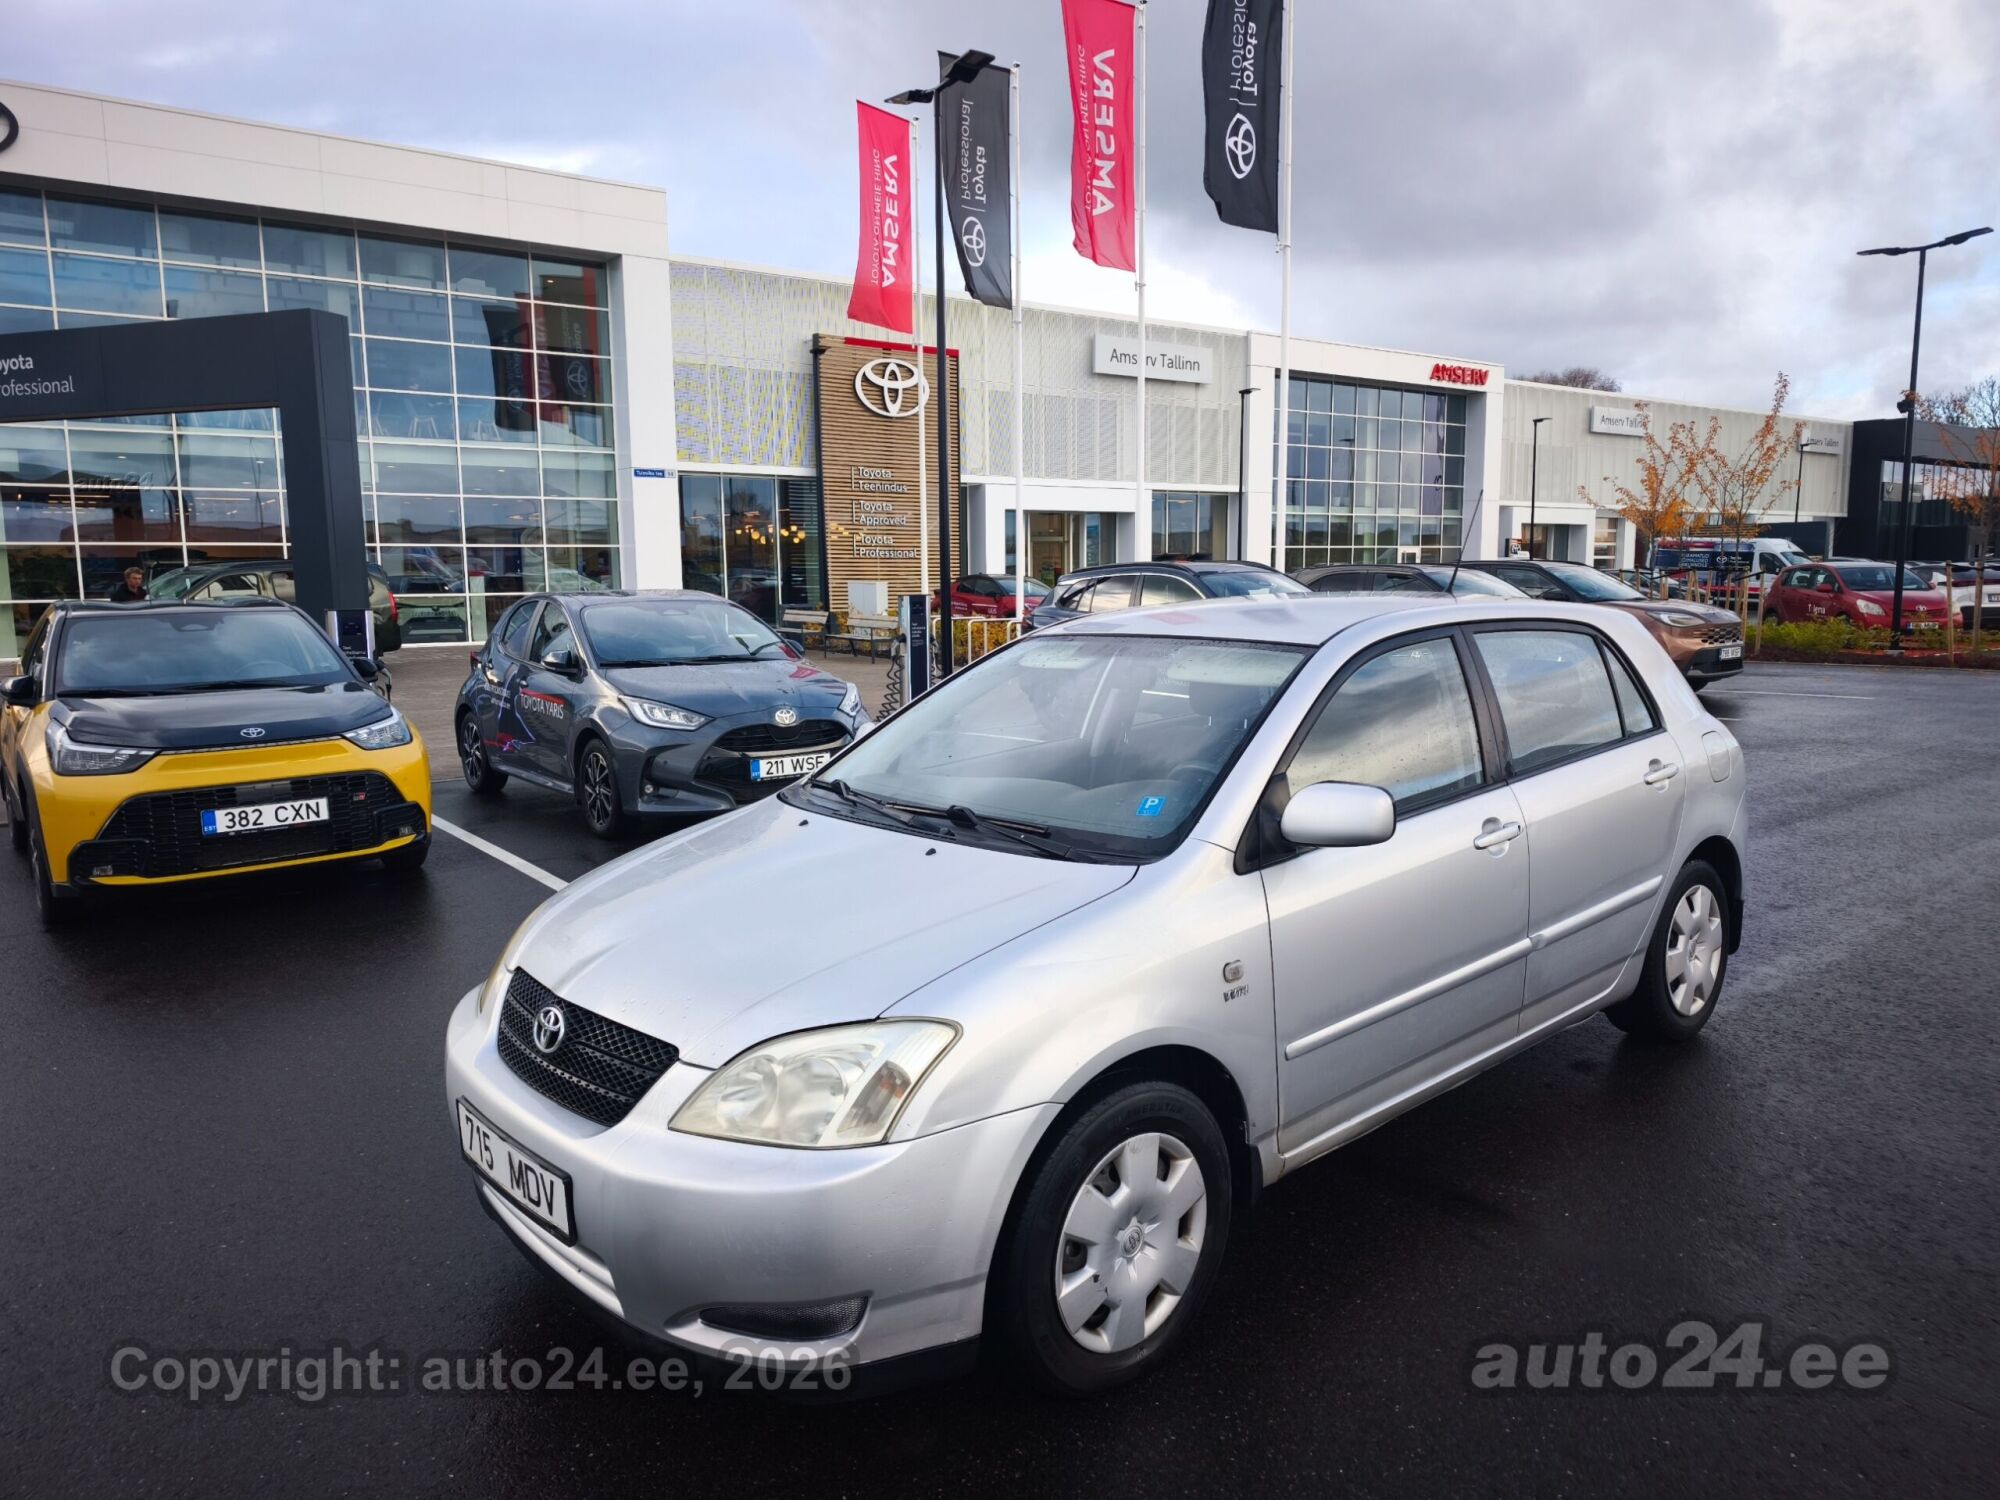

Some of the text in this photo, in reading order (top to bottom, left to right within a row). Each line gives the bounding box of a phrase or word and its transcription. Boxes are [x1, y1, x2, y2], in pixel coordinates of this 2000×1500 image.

[0, 354, 34, 375] yota
[1109, 348, 1201, 371] Amsrv Tallinn
[1429, 363, 1490, 386] AMSERV
[0, 375, 75, 397] ofessional
[1601, 415, 1625, 427] Amserv
[858, 466, 892, 479] Toyota
[859, 480, 908, 492] Teenindus
[860, 500, 893, 513] Toyota
[860, 514, 907, 526] Approved
[861, 533, 894, 546] Toyota
[859, 548, 919, 558] Professional
[520, 693, 545, 713] TOYOTA
[545, 701, 564, 719] YARIS
[766, 759, 785, 775] 211
[224, 801, 321, 829] 382 CXN
[465, 1114, 554, 1217] 715 MDV
